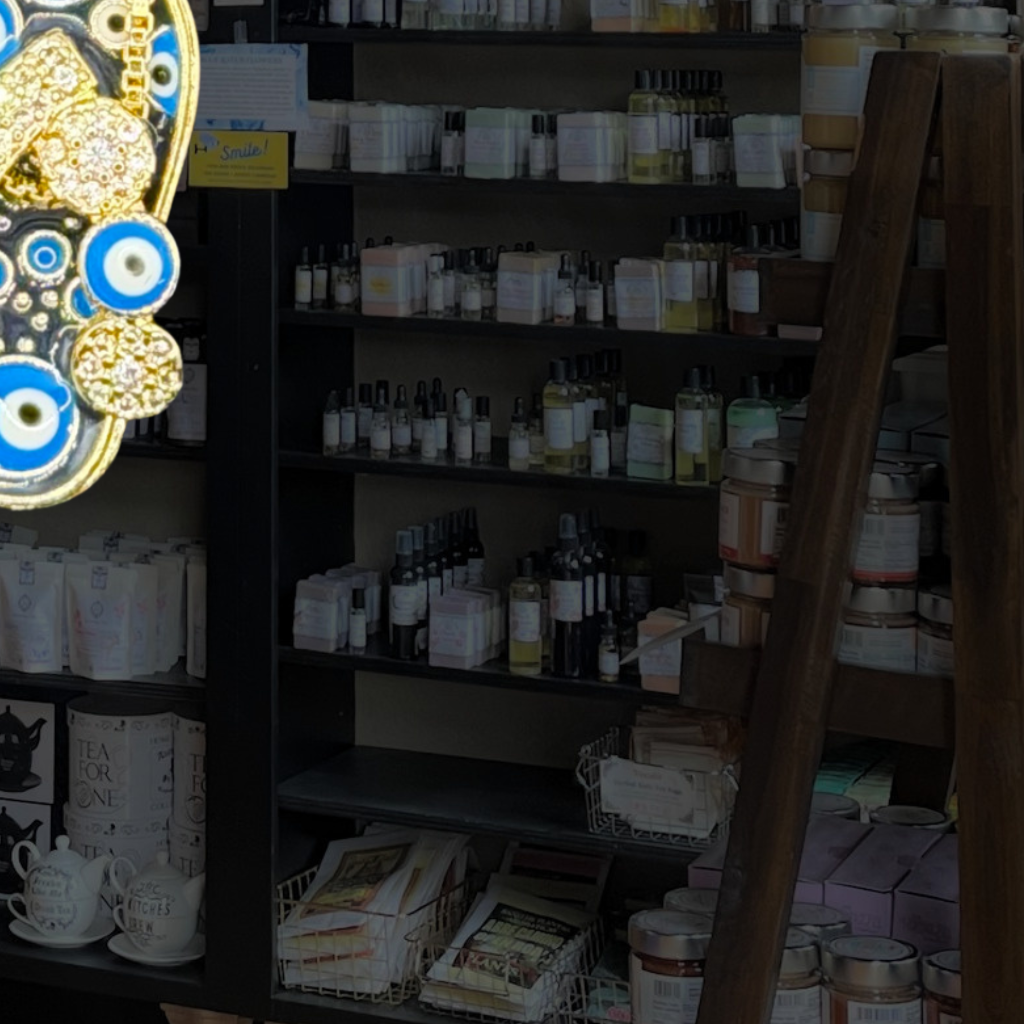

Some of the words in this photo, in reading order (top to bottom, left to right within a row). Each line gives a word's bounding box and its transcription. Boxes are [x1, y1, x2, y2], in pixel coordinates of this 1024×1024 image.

[220, 139, 268, 161] Smile!
[77, 738, 110, 761] TEA
[79, 762, 113, 782] FOR
[76, 780, 125, 809] ONE
